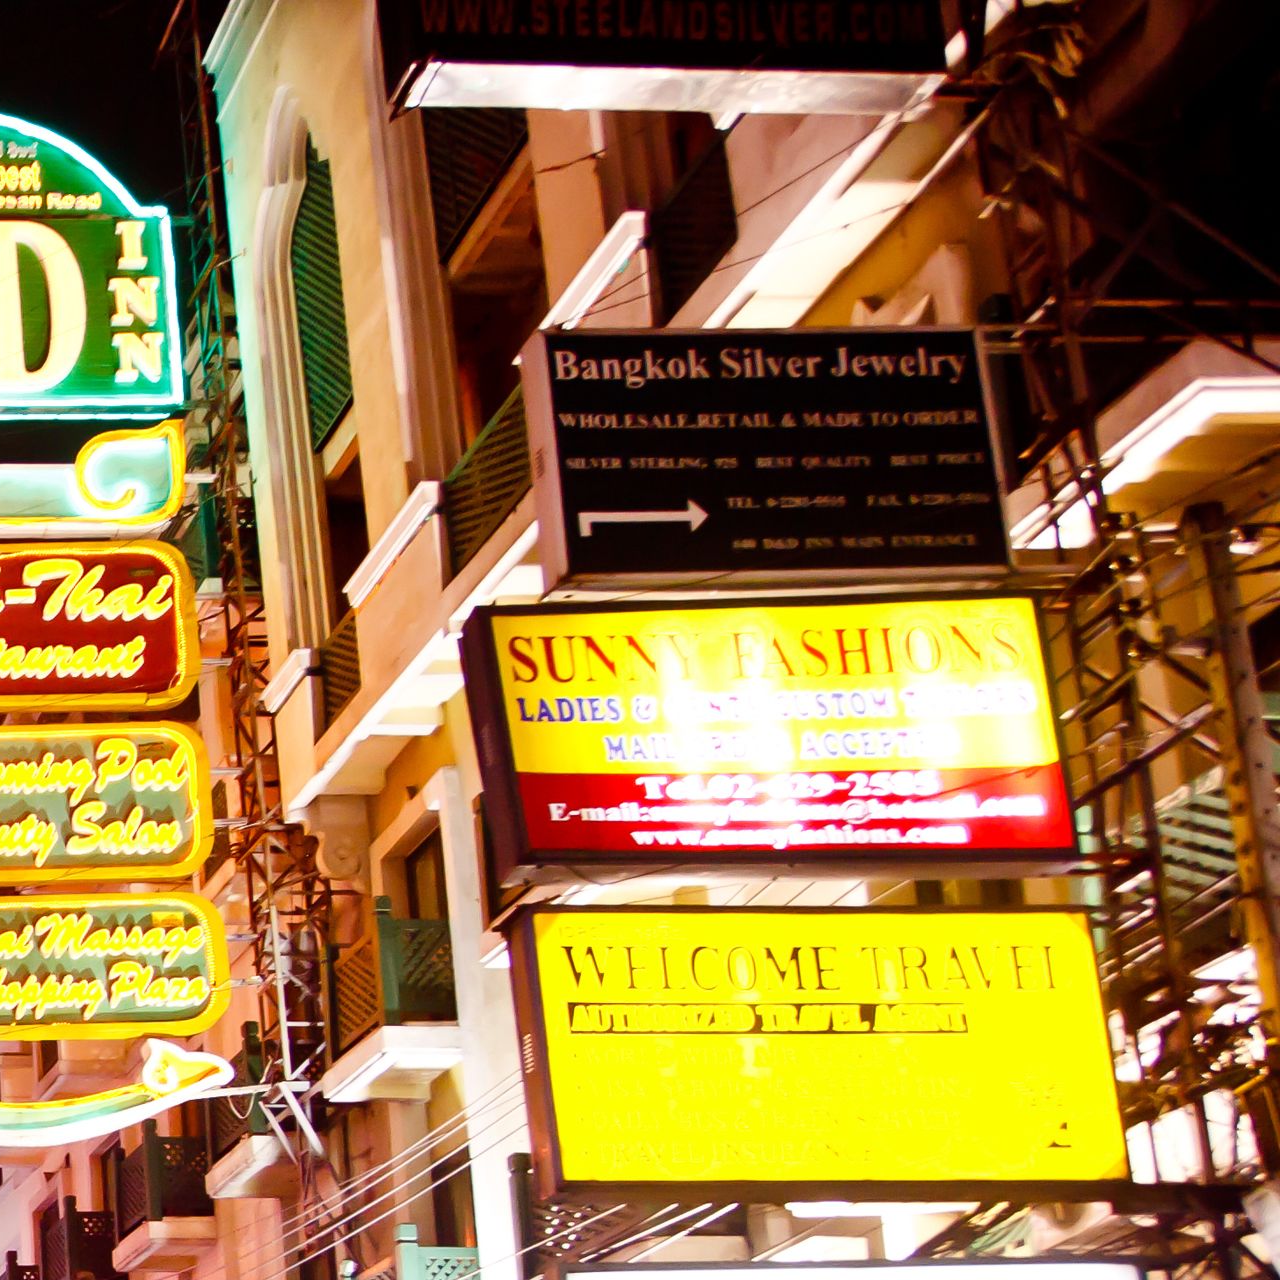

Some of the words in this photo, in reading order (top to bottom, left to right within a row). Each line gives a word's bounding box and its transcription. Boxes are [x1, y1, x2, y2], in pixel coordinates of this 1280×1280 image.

[46, 191, 102, 210] Road
[107, 220, 165, 384] INN
[553, 348, 710, 388] Bangkok
[719, 347, 822, 378] Silver
[831, 346, 966, 384] Jewelry
[781, 412, 796, 427] &
[801, 411, 864, 427] MADE
[869, 410, 899, 427] TO
[902, 408, 979, 426] ORDER
[565, 456, 622, 469] SILVER
[508, 633, 705, 683] SUNNY
[730, 623, 1020, 679] FASHIONS
[515, 695, 623, 723] LADIES
[775, 690, 894, 717] CUSTOM
[93, 737, 190, 792] Pool
[605, 735, 676, 761] MAIL
[65, 800, 183, 857] Salon
[30, 911, 206, 964] Massage
[107, 962, 209, 1011] Plaza
[560, 944, 838, 991] WELCOME
[861, 943, 1065, 990] TRAVEL
[756, 1003, 870, 1032] TRAVEL
[872, 1003, 968, 1032] AGENT
